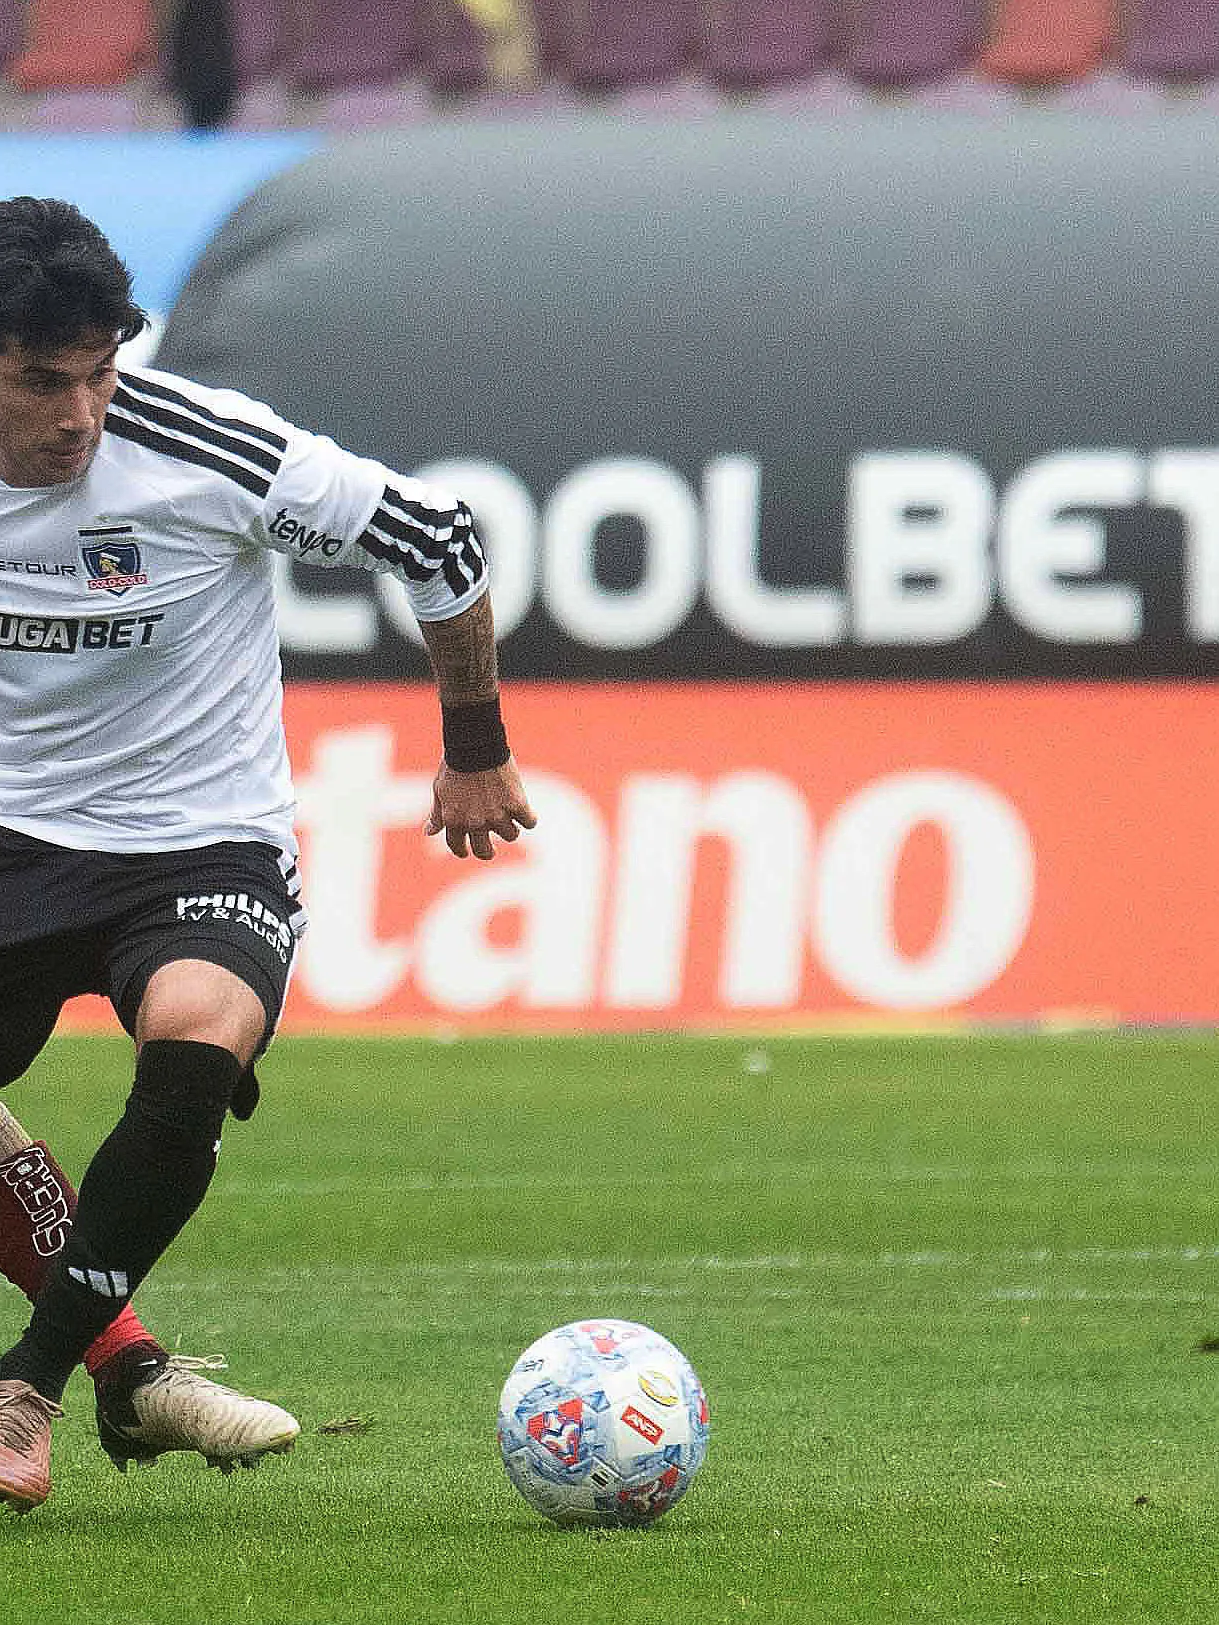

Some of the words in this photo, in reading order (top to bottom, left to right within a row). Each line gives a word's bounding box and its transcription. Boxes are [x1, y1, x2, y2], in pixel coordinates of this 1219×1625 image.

[176, 893, 292, 948] PHILIPS
[212, 906, 231, 920] &
[235, 912, 288, 964] Audio
